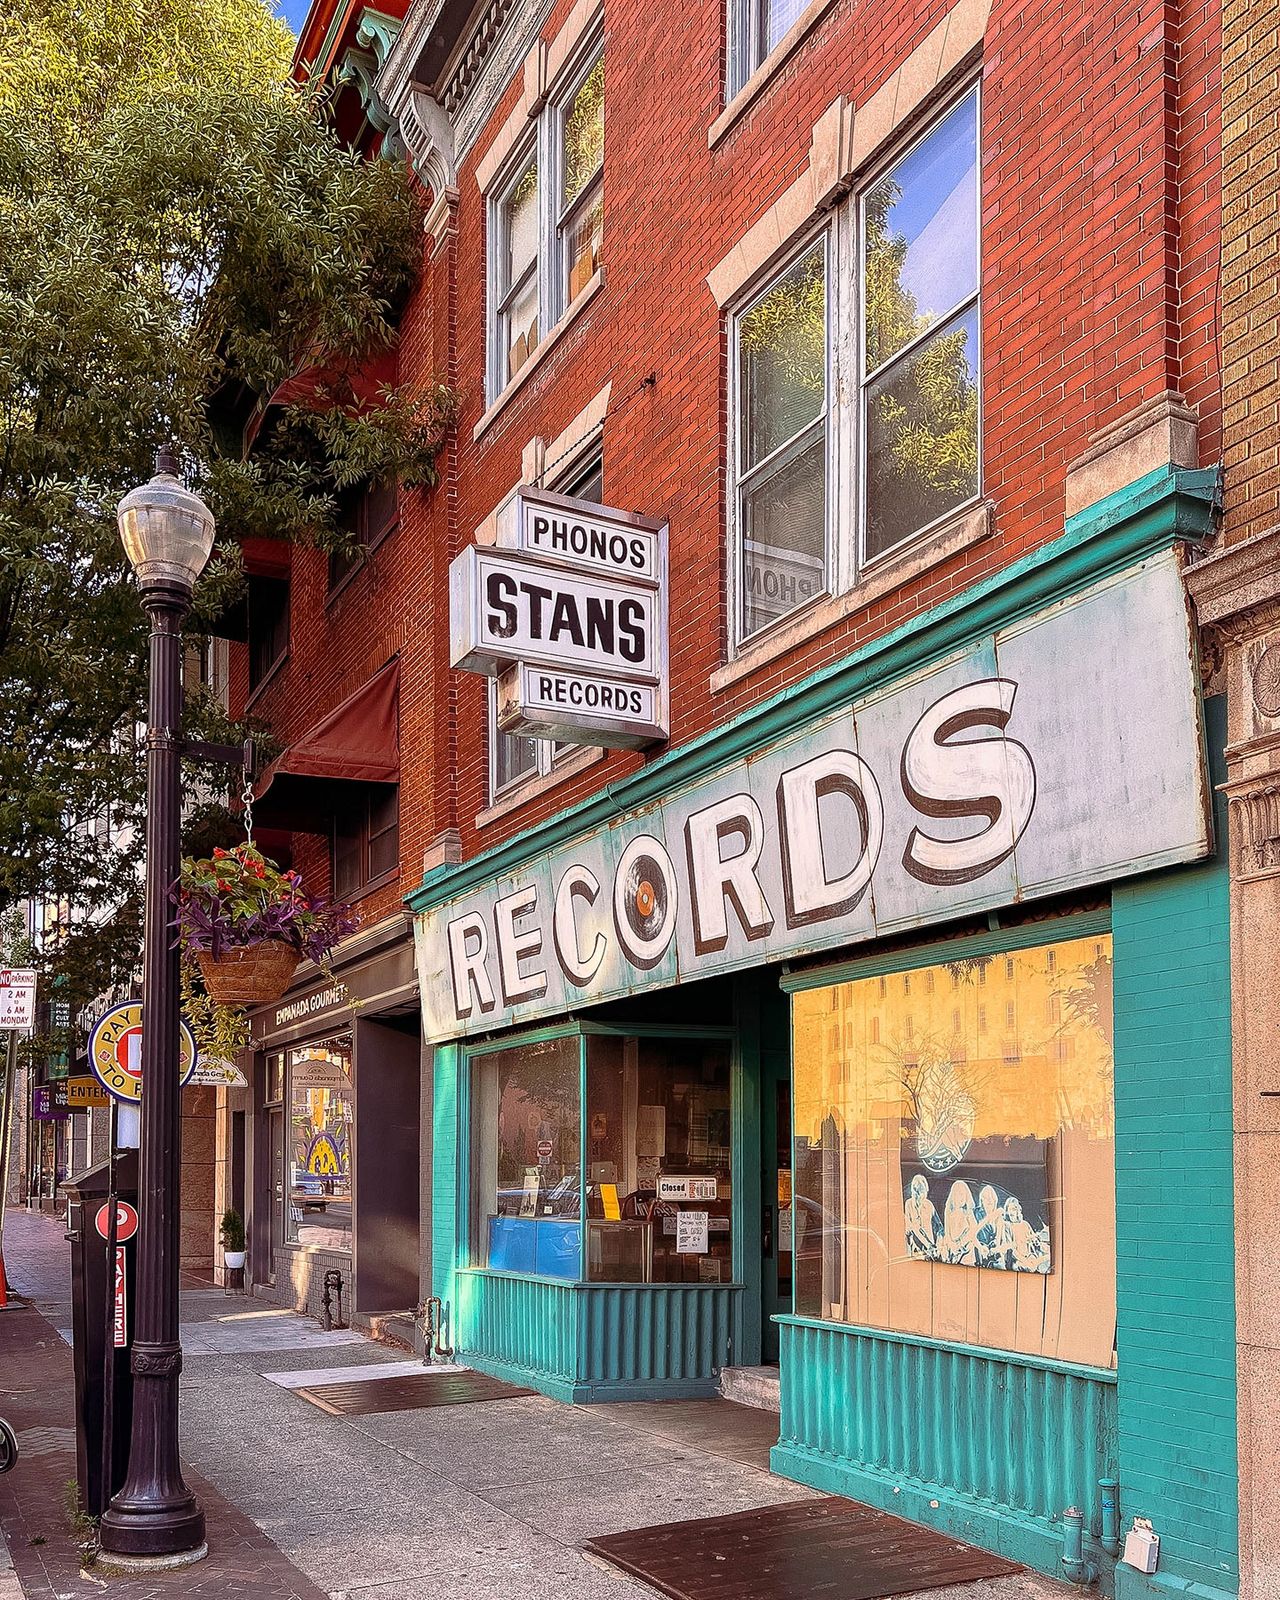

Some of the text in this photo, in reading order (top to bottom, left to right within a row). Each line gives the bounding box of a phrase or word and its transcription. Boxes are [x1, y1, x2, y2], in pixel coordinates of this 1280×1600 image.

[533, 516, 646, 569] PHONOS
[486, 573, 646, 662] STANS
[539, 677, 643, 714] RECORDS
[447, 677, 1037, 1021] RECORDS
[0, 973, 34, 985] NO PARKING
[8, 990, 26, 998] 2 AM
[275, 984, 346, 1026] EMPANADA GOURMET
[1, 1016, 29, 1024] MONDAY
[6, 1006, 25, 1014] 6 AM
[101, 1010, 131, 1044] PAY
[103, 1064, 125, 1088] TO
[70, 1085, 107, 1098] ENTER
[661, 1183, 686, 1191] Closed
